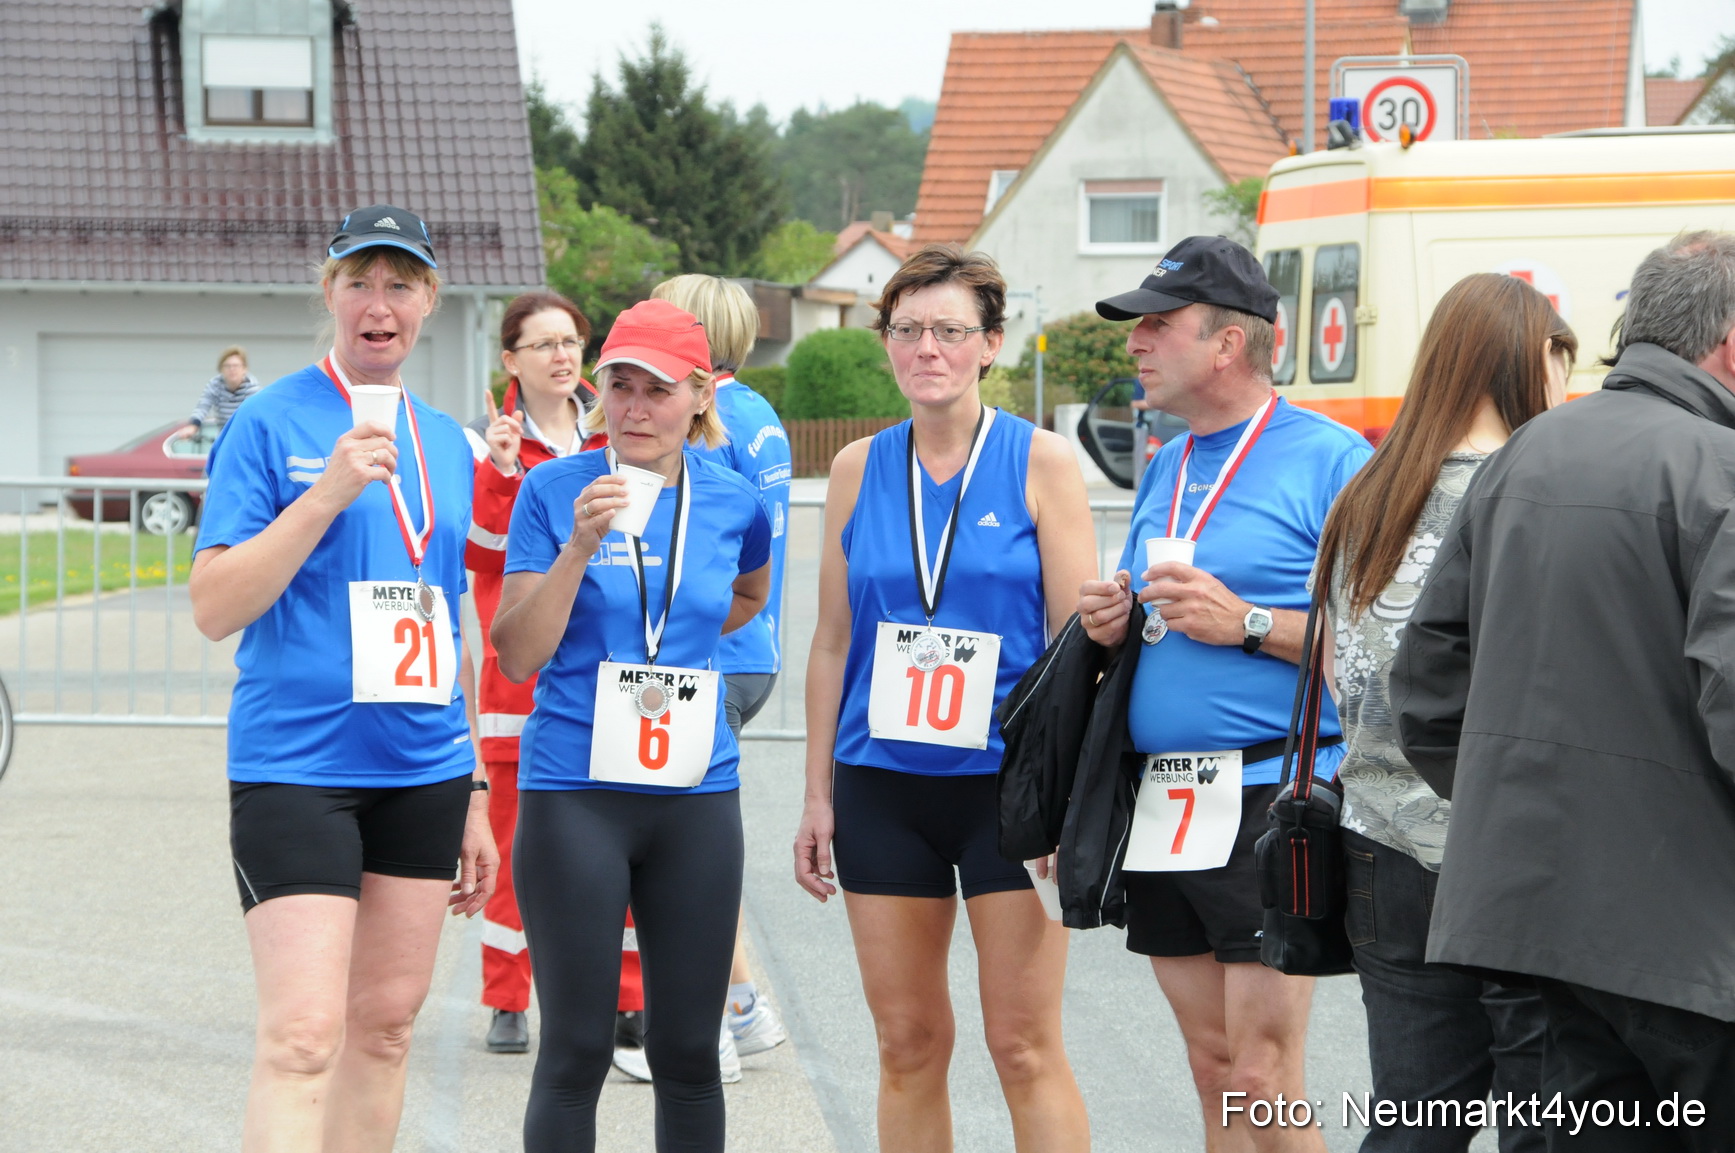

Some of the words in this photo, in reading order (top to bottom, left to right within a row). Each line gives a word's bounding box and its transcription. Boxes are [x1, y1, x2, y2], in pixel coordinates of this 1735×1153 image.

[1378, 97, 1421, 131] 30
[374, 222, 400, 231] adidas
[1159, 258, 1184, 271] SPORT
[372, 586, 415, 600] MEYE
[372, 601, 417, 611] WERBUN
[394, 617, 437, 688] 21
[906, 664, 965, 731] 10
[638, 709, 670, 770] 6
[1151, 758, 1192, 772] MEYER
[1150, 772, 1194, 783] WERBUNG
[1167, 788, 1195, 854] 7
